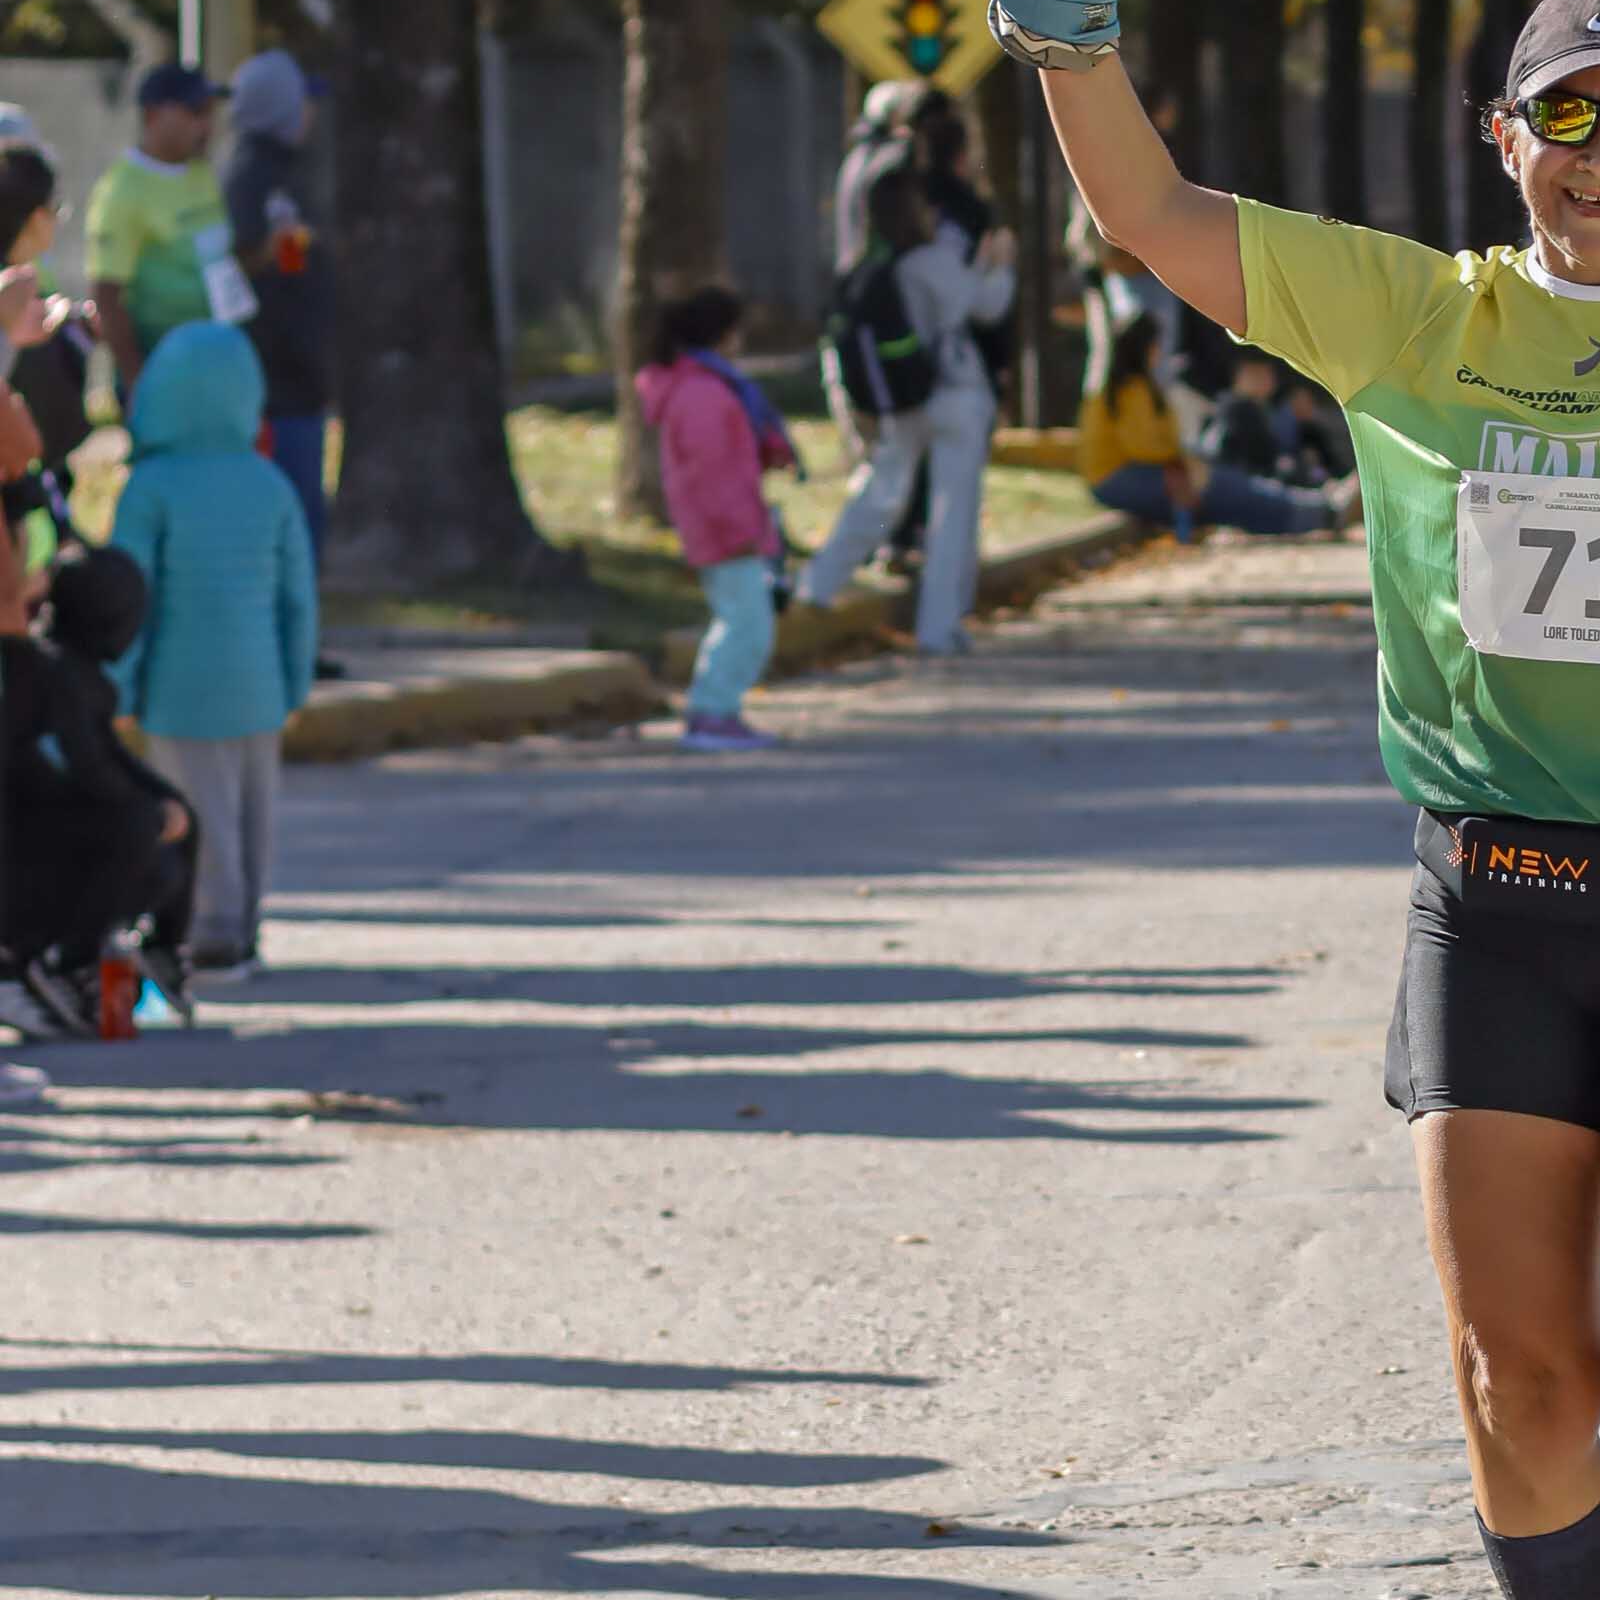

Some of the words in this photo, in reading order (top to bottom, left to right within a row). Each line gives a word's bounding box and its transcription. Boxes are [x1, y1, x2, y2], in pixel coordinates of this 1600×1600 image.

[1543, 626, 1568, 640] LORE
[1488, 844, 1589, 879] NEW
[1487, 871, 1587, 893] TRAINING
